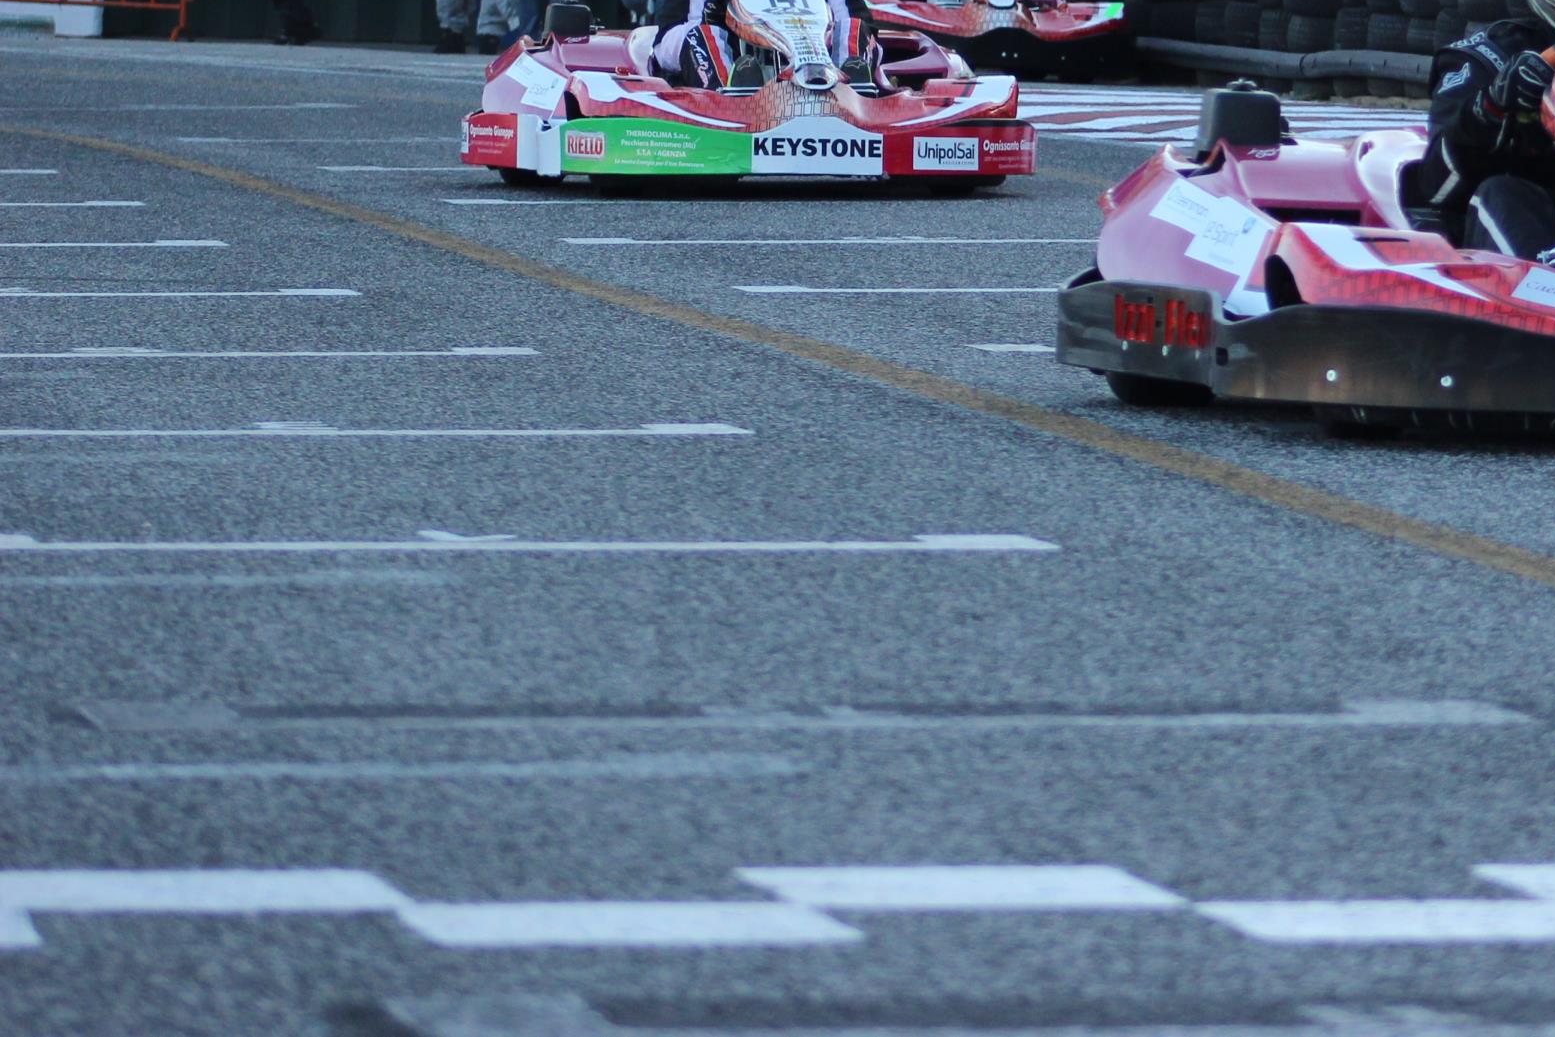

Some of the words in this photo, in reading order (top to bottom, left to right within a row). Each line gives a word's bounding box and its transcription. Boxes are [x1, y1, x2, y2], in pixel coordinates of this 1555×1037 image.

[567, 136, 604, 155] RIELLO
[753, 137, 882, 158] KEYSTONE
[917, 140, 976, 165] UnipolSai
